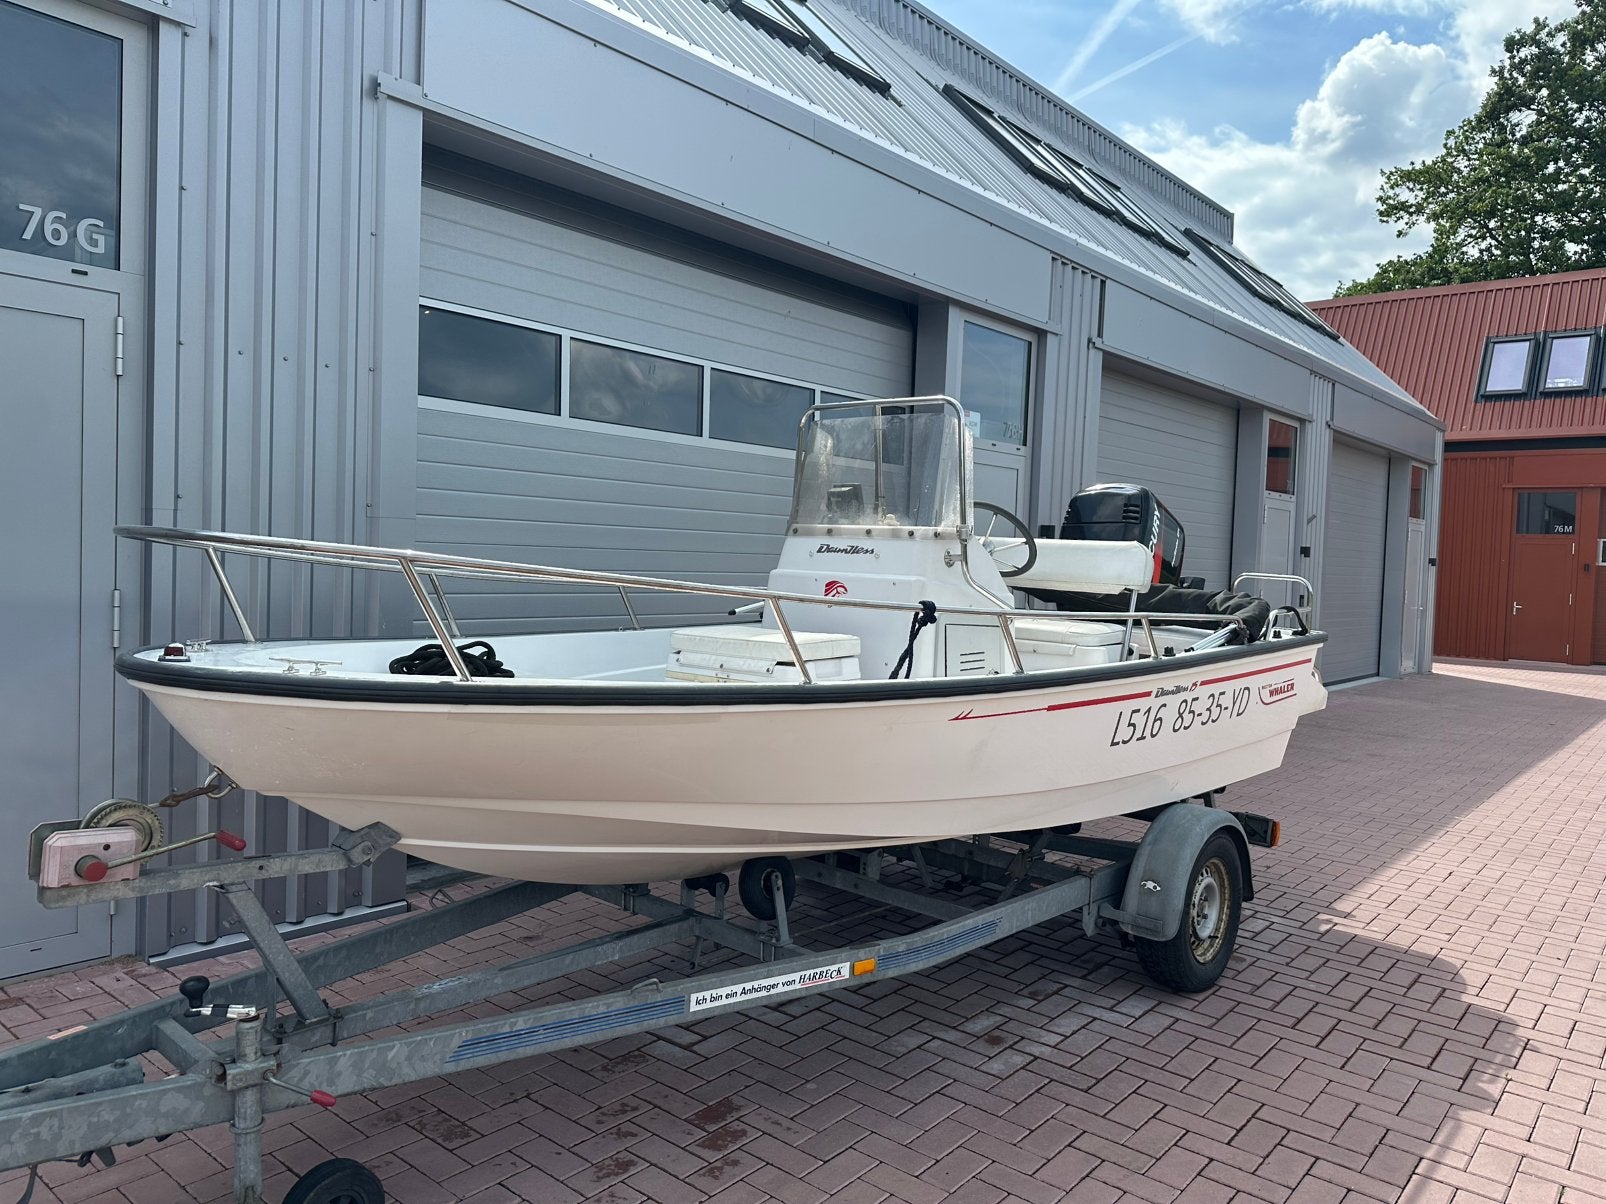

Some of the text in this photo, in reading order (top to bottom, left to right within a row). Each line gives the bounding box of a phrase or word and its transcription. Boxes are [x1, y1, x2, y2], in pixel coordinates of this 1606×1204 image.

[19, 203, 105, 254] 76 G
[1554, 525, 1573, 533] 76 M
[816, 543, 875, 555] Dauntless
[1189, 680, 1199, 692] 15
[1268, 682, 1295, 698] WHALER
[1110, 686, 1251, 747] L516 85-35-YD
[695, 966, 843, 1006] Ich bin ein Anhänger von HARBECK
